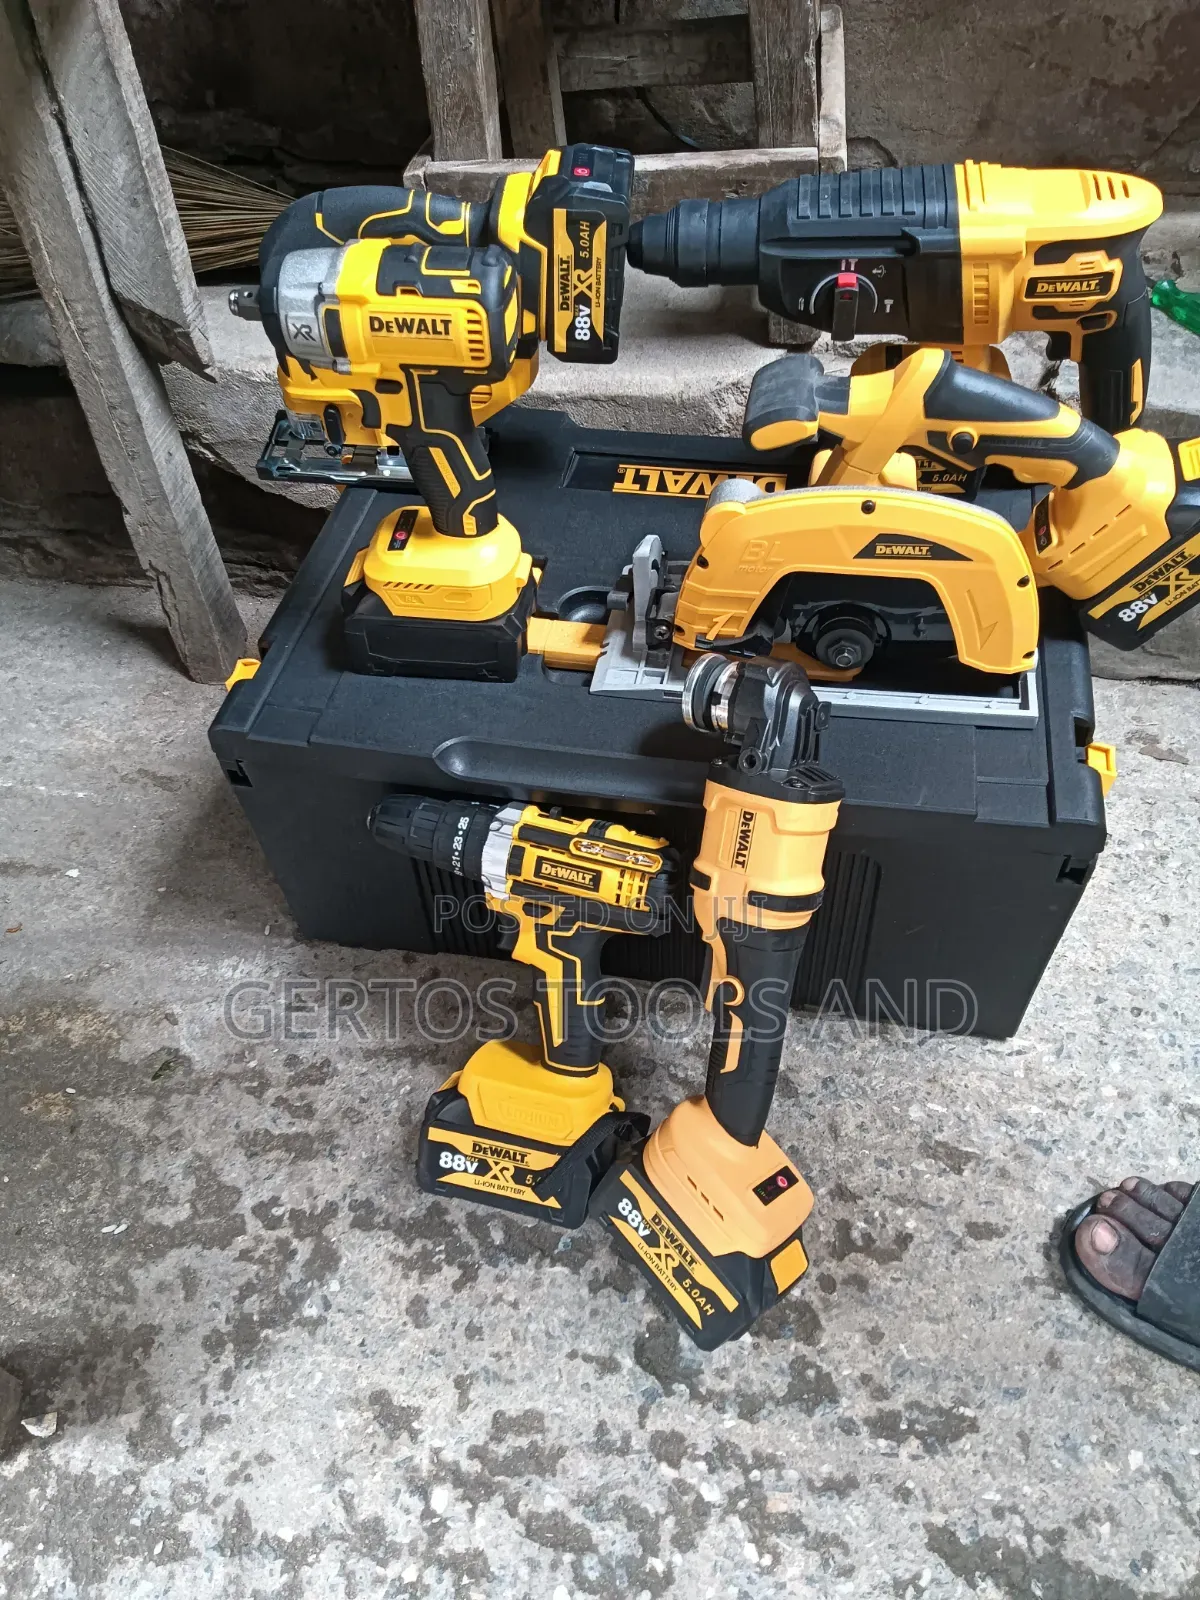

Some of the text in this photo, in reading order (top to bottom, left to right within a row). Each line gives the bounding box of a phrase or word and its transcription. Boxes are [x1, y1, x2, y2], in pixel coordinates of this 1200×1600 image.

[579, 220, 590, 258] 5.0AH
[573, 268, 594, 298] XR
[595, 257, 603, 287] BATTERY
[289, 322, 317, 342] XR
[483, 1159, 516, 1184] XR
[496, 1184, 526, 1197] BATTERY
[648, 1239, 681, 1273] XR
[654, 1262, 679, 1292] BATTERY
[682, 1278, 716, 1316] 5.0AH
